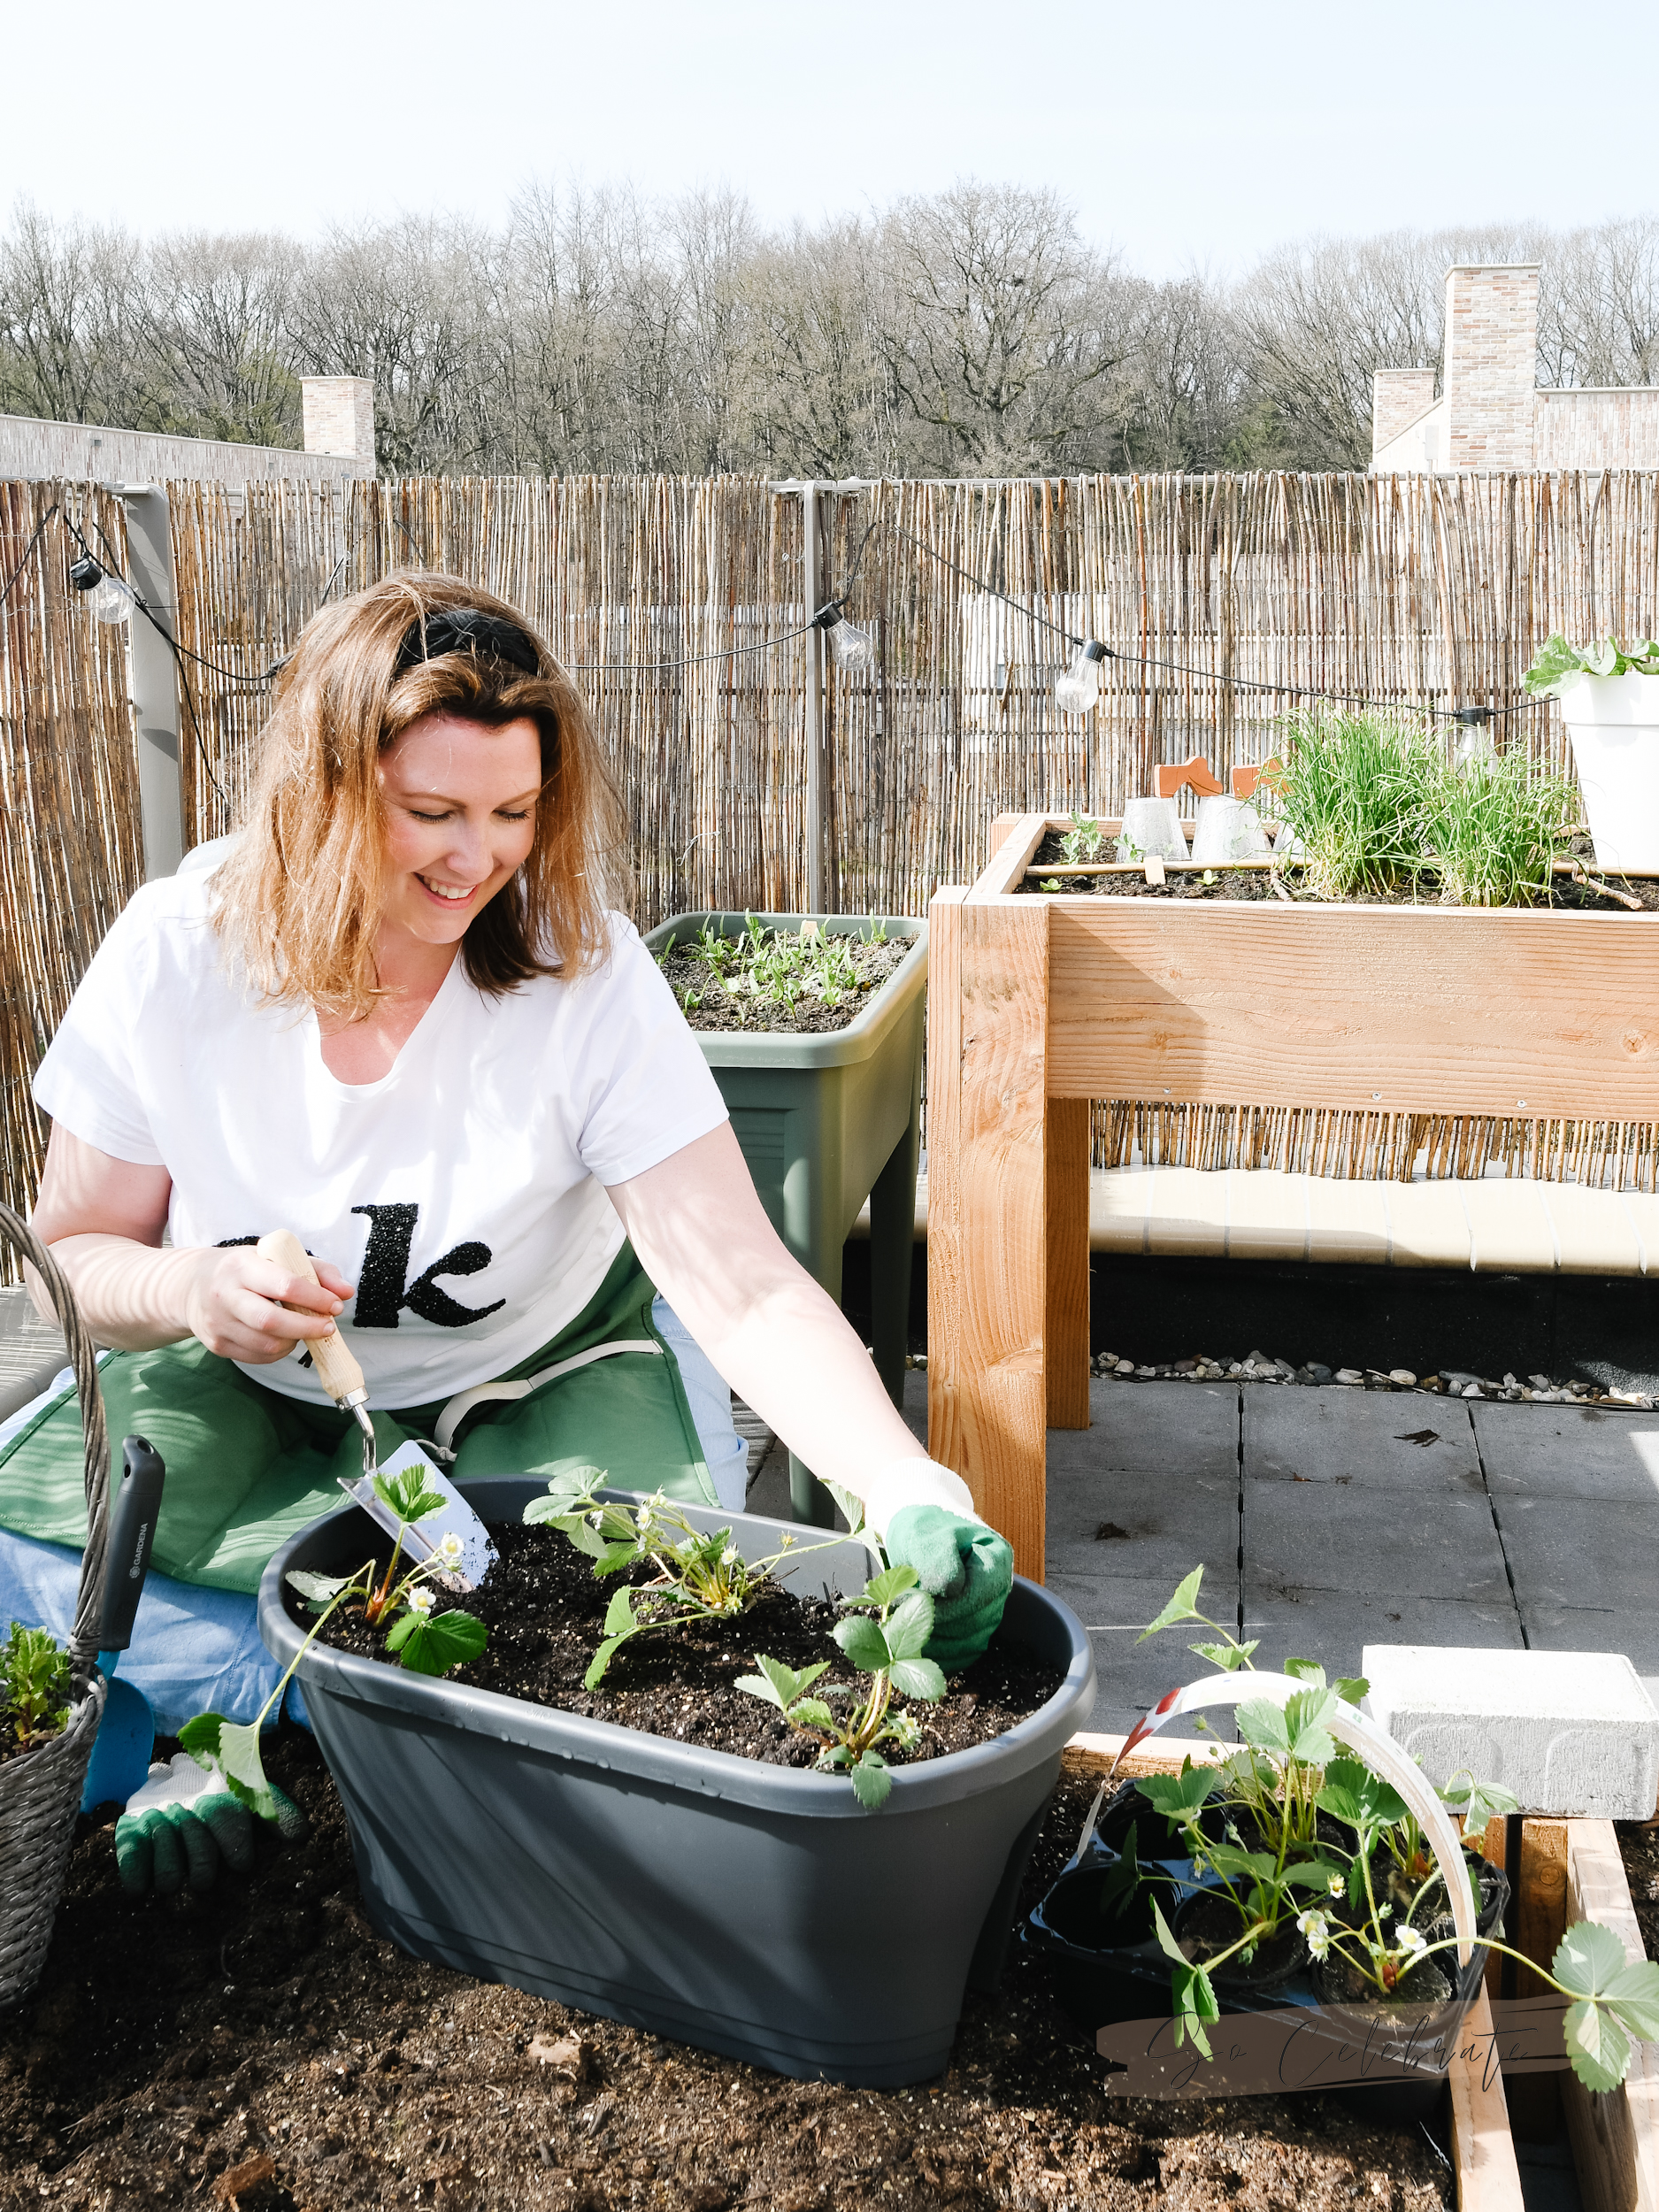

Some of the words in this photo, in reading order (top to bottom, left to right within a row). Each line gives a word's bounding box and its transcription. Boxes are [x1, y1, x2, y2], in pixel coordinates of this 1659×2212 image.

[134, 1523, 149, 1566] GARDENA
[1360, 1742, 1391, 1775] OSTARA
[1393, 1774, 1425, 1821] FRAGARIA
